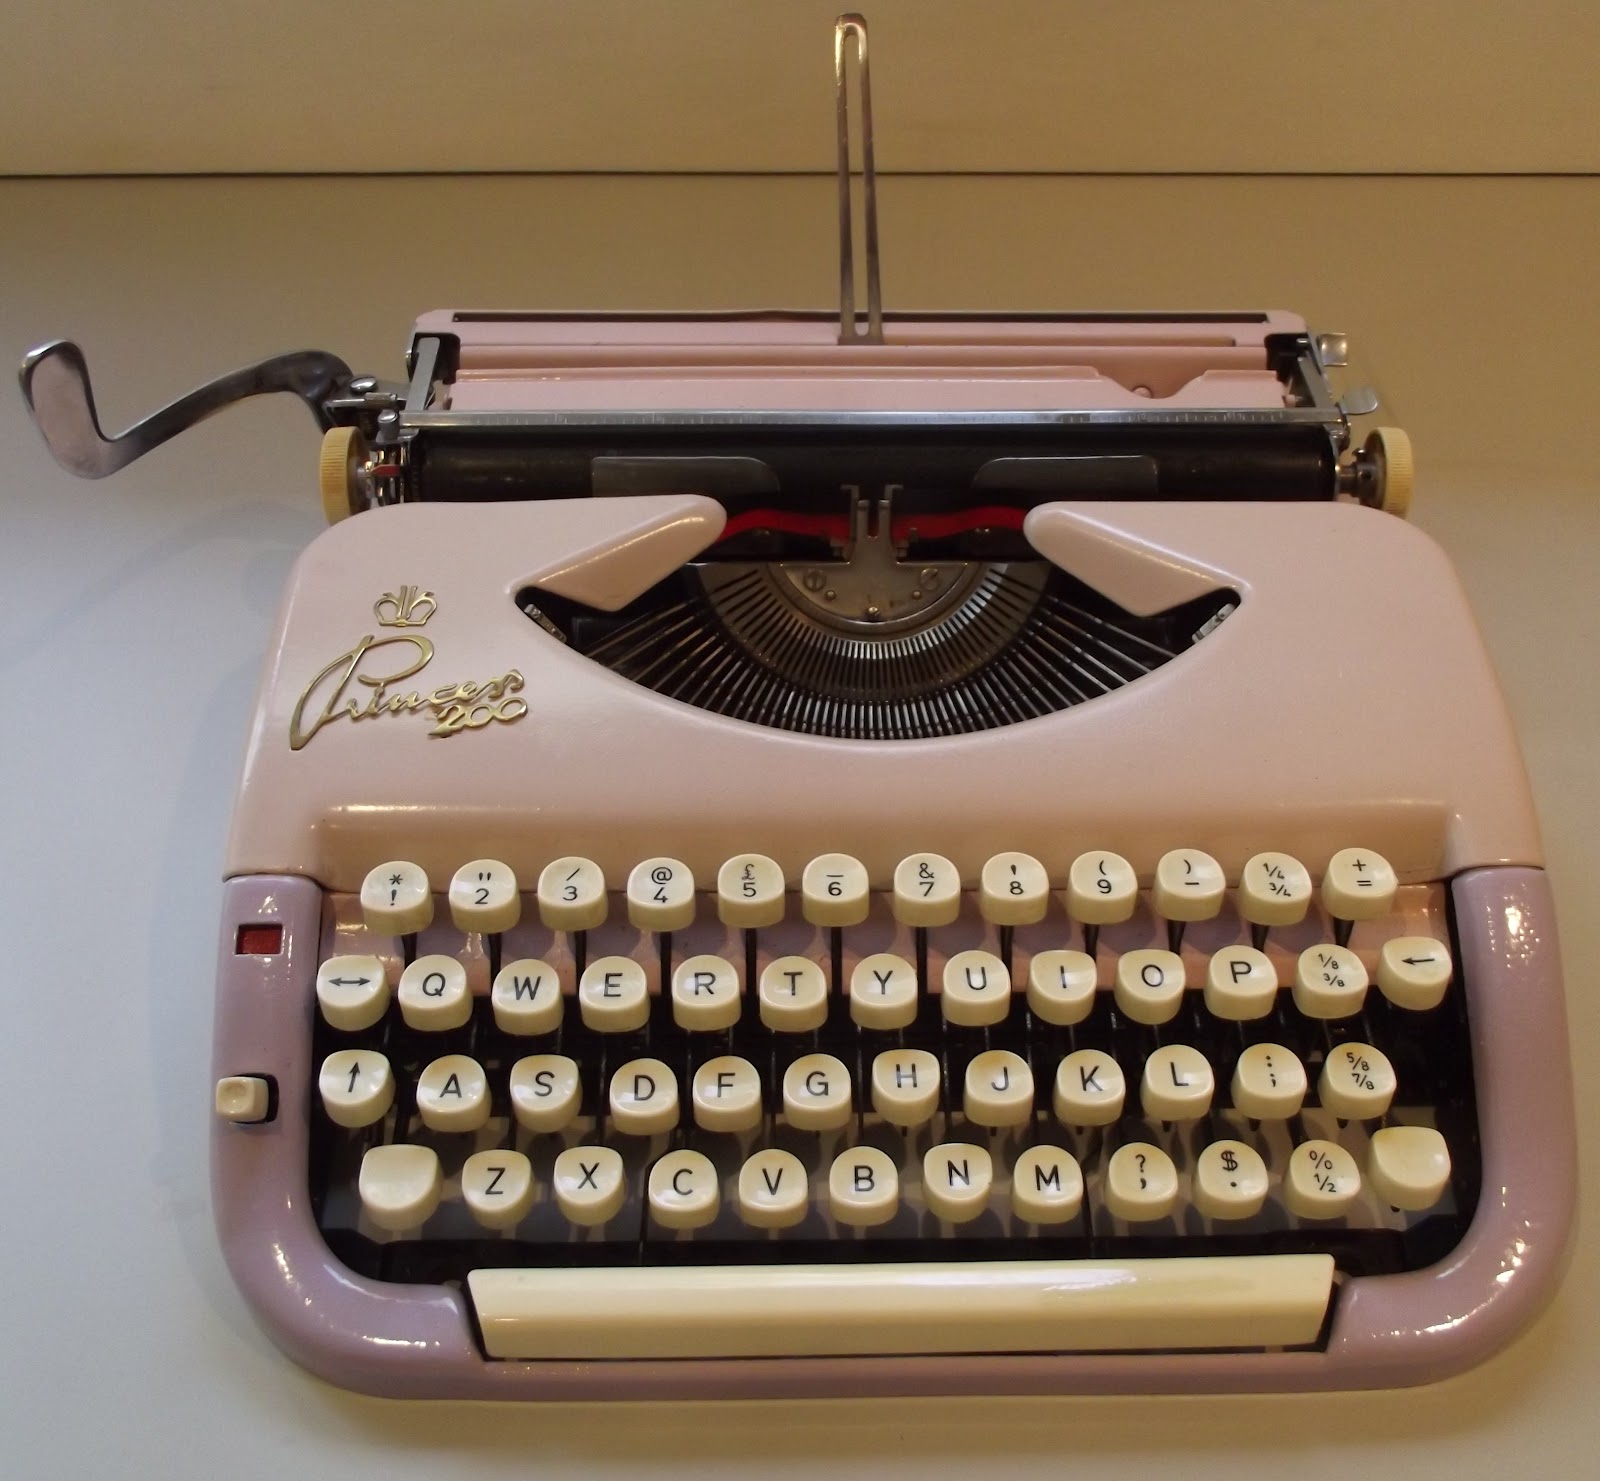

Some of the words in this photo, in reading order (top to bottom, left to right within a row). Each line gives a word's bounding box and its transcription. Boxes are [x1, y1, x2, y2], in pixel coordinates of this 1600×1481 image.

[290, 634, 525, 751] Princess
[427, 697, 528, 738] 200
[650, 866, 673, 885] @
[741, 863, 756, 881] £
[918, 862, 935, 879] &
[1352, 858, 1367, 872] +
[474, 887, 490, 905] 2
[562, 885, 578, 902] 3
[653, 886, 668, 904] 4
[742, 881, 757, 898] 5
[827, 881, 843, 897] 6
[919, 881, 935, 897] 7
[1009, 880, 1025, 896] 8
[1096, 878, 1112, 895] 9
[422, 972, 446, 997] Q
[603, 972, 623, 998] E
[694, 971, 716, 996] R
[783, 971, 804, 997] T
[872, 970, 894, 996] Y
[965, 966, 987, 991] U
[1140, 963, 1164, 988] O
[1229, 960, 1252, 984] P
[513, 975, 542, 1001] W
[439, 1073, 463, 1099] A
[534, 1070, 556, 1097] S
[717, 1072, 736, 1099] F
[805, 1070, 829, 1097] G
[895, 1063, 918, 1089] H
[991, 1066, 1010, 1092] J
[1079, 1065, 1104, 1092] K
[1169, 1061, 1190, 1087] L
[633, 1074, 656, 1102] D
[947, 1159, 970, 1187] N
[1135, 1153, 1146, 1174] ?
[1220, 1149, 1239, 1172] $
[484, 1167, 506, 1196] Z
[577, 1162, 600, 1190] X
[672, 1168, 694, 1196] C
[761, 1167, 784, 1196] V
[853, 1164, 875, 1192] B
[1034, 1164, 1061, 1192] M
